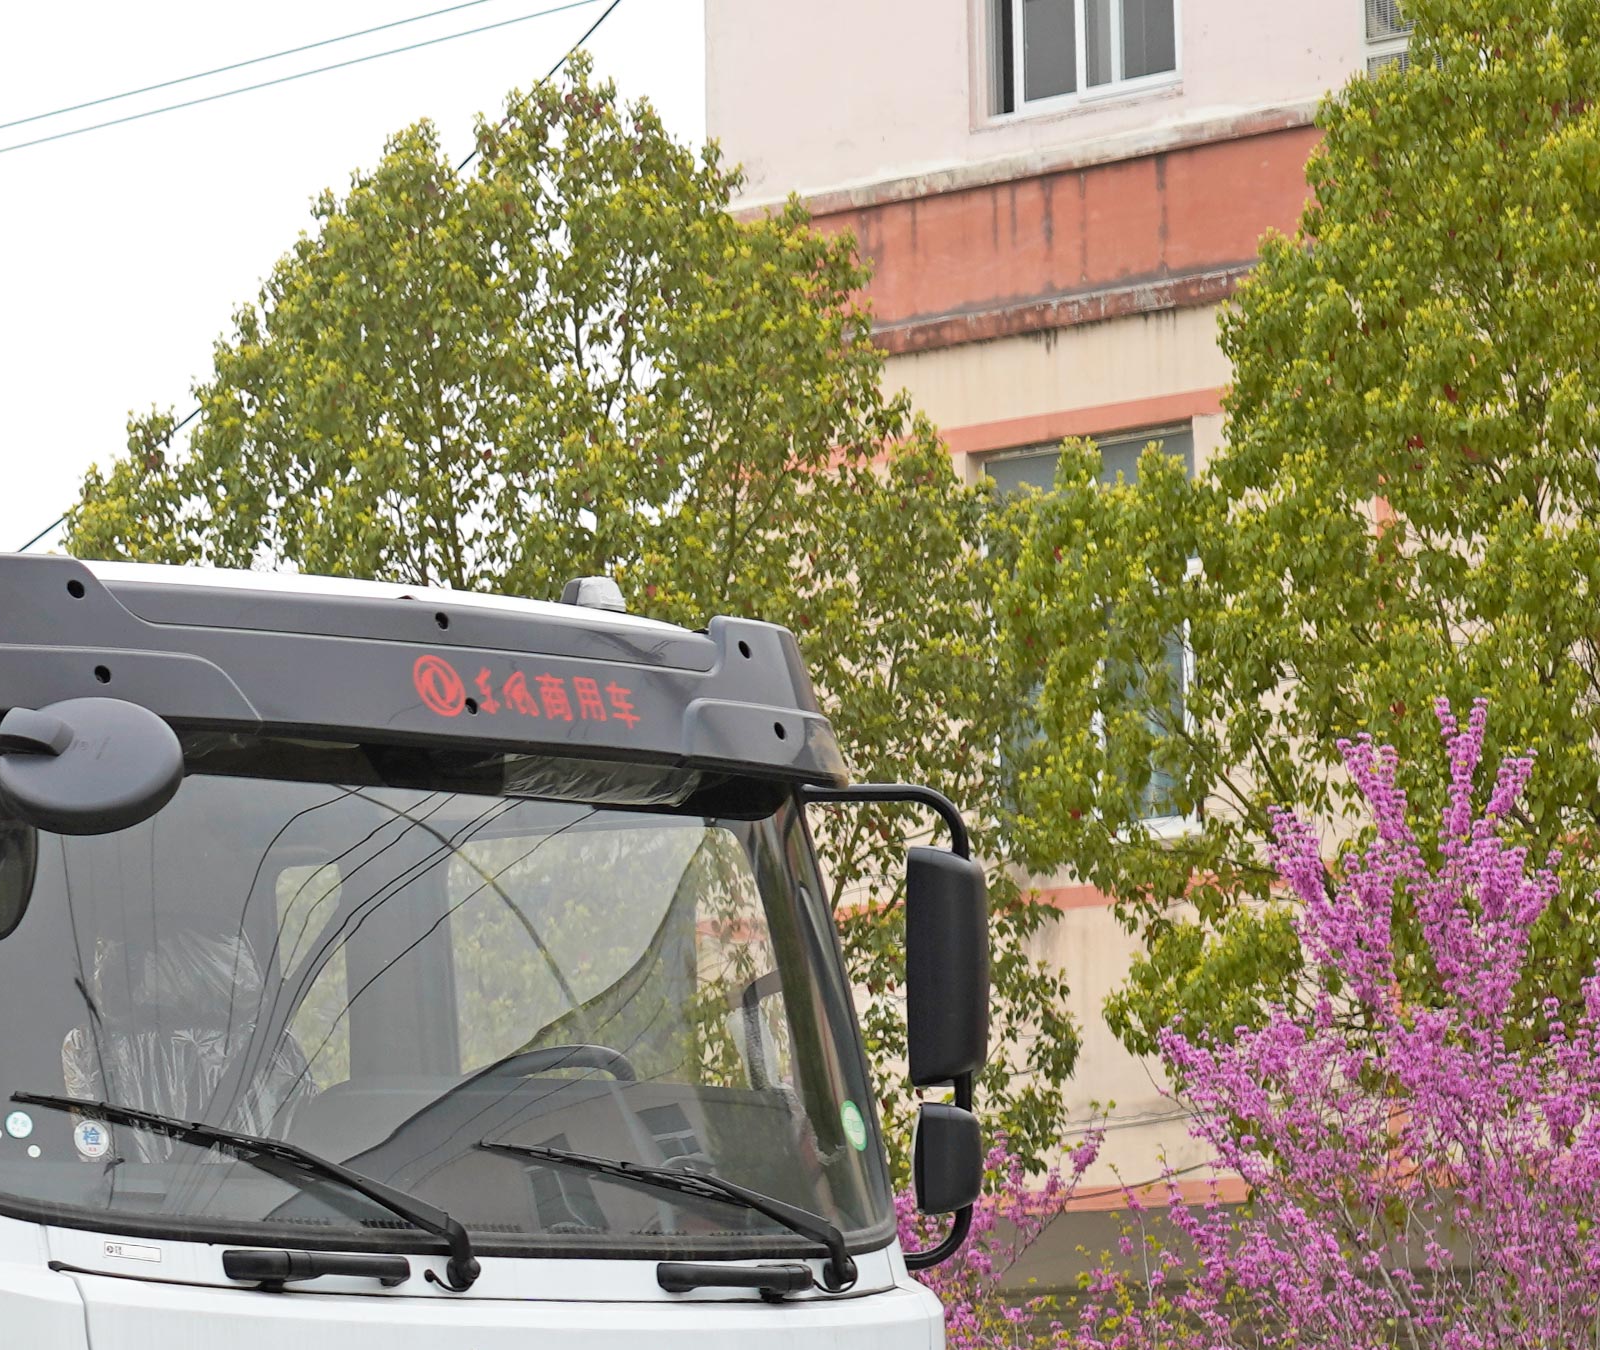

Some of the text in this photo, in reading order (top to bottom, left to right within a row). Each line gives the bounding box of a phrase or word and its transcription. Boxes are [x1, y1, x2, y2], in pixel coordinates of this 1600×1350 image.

[475, 667, 640, 729] 东风商用车
